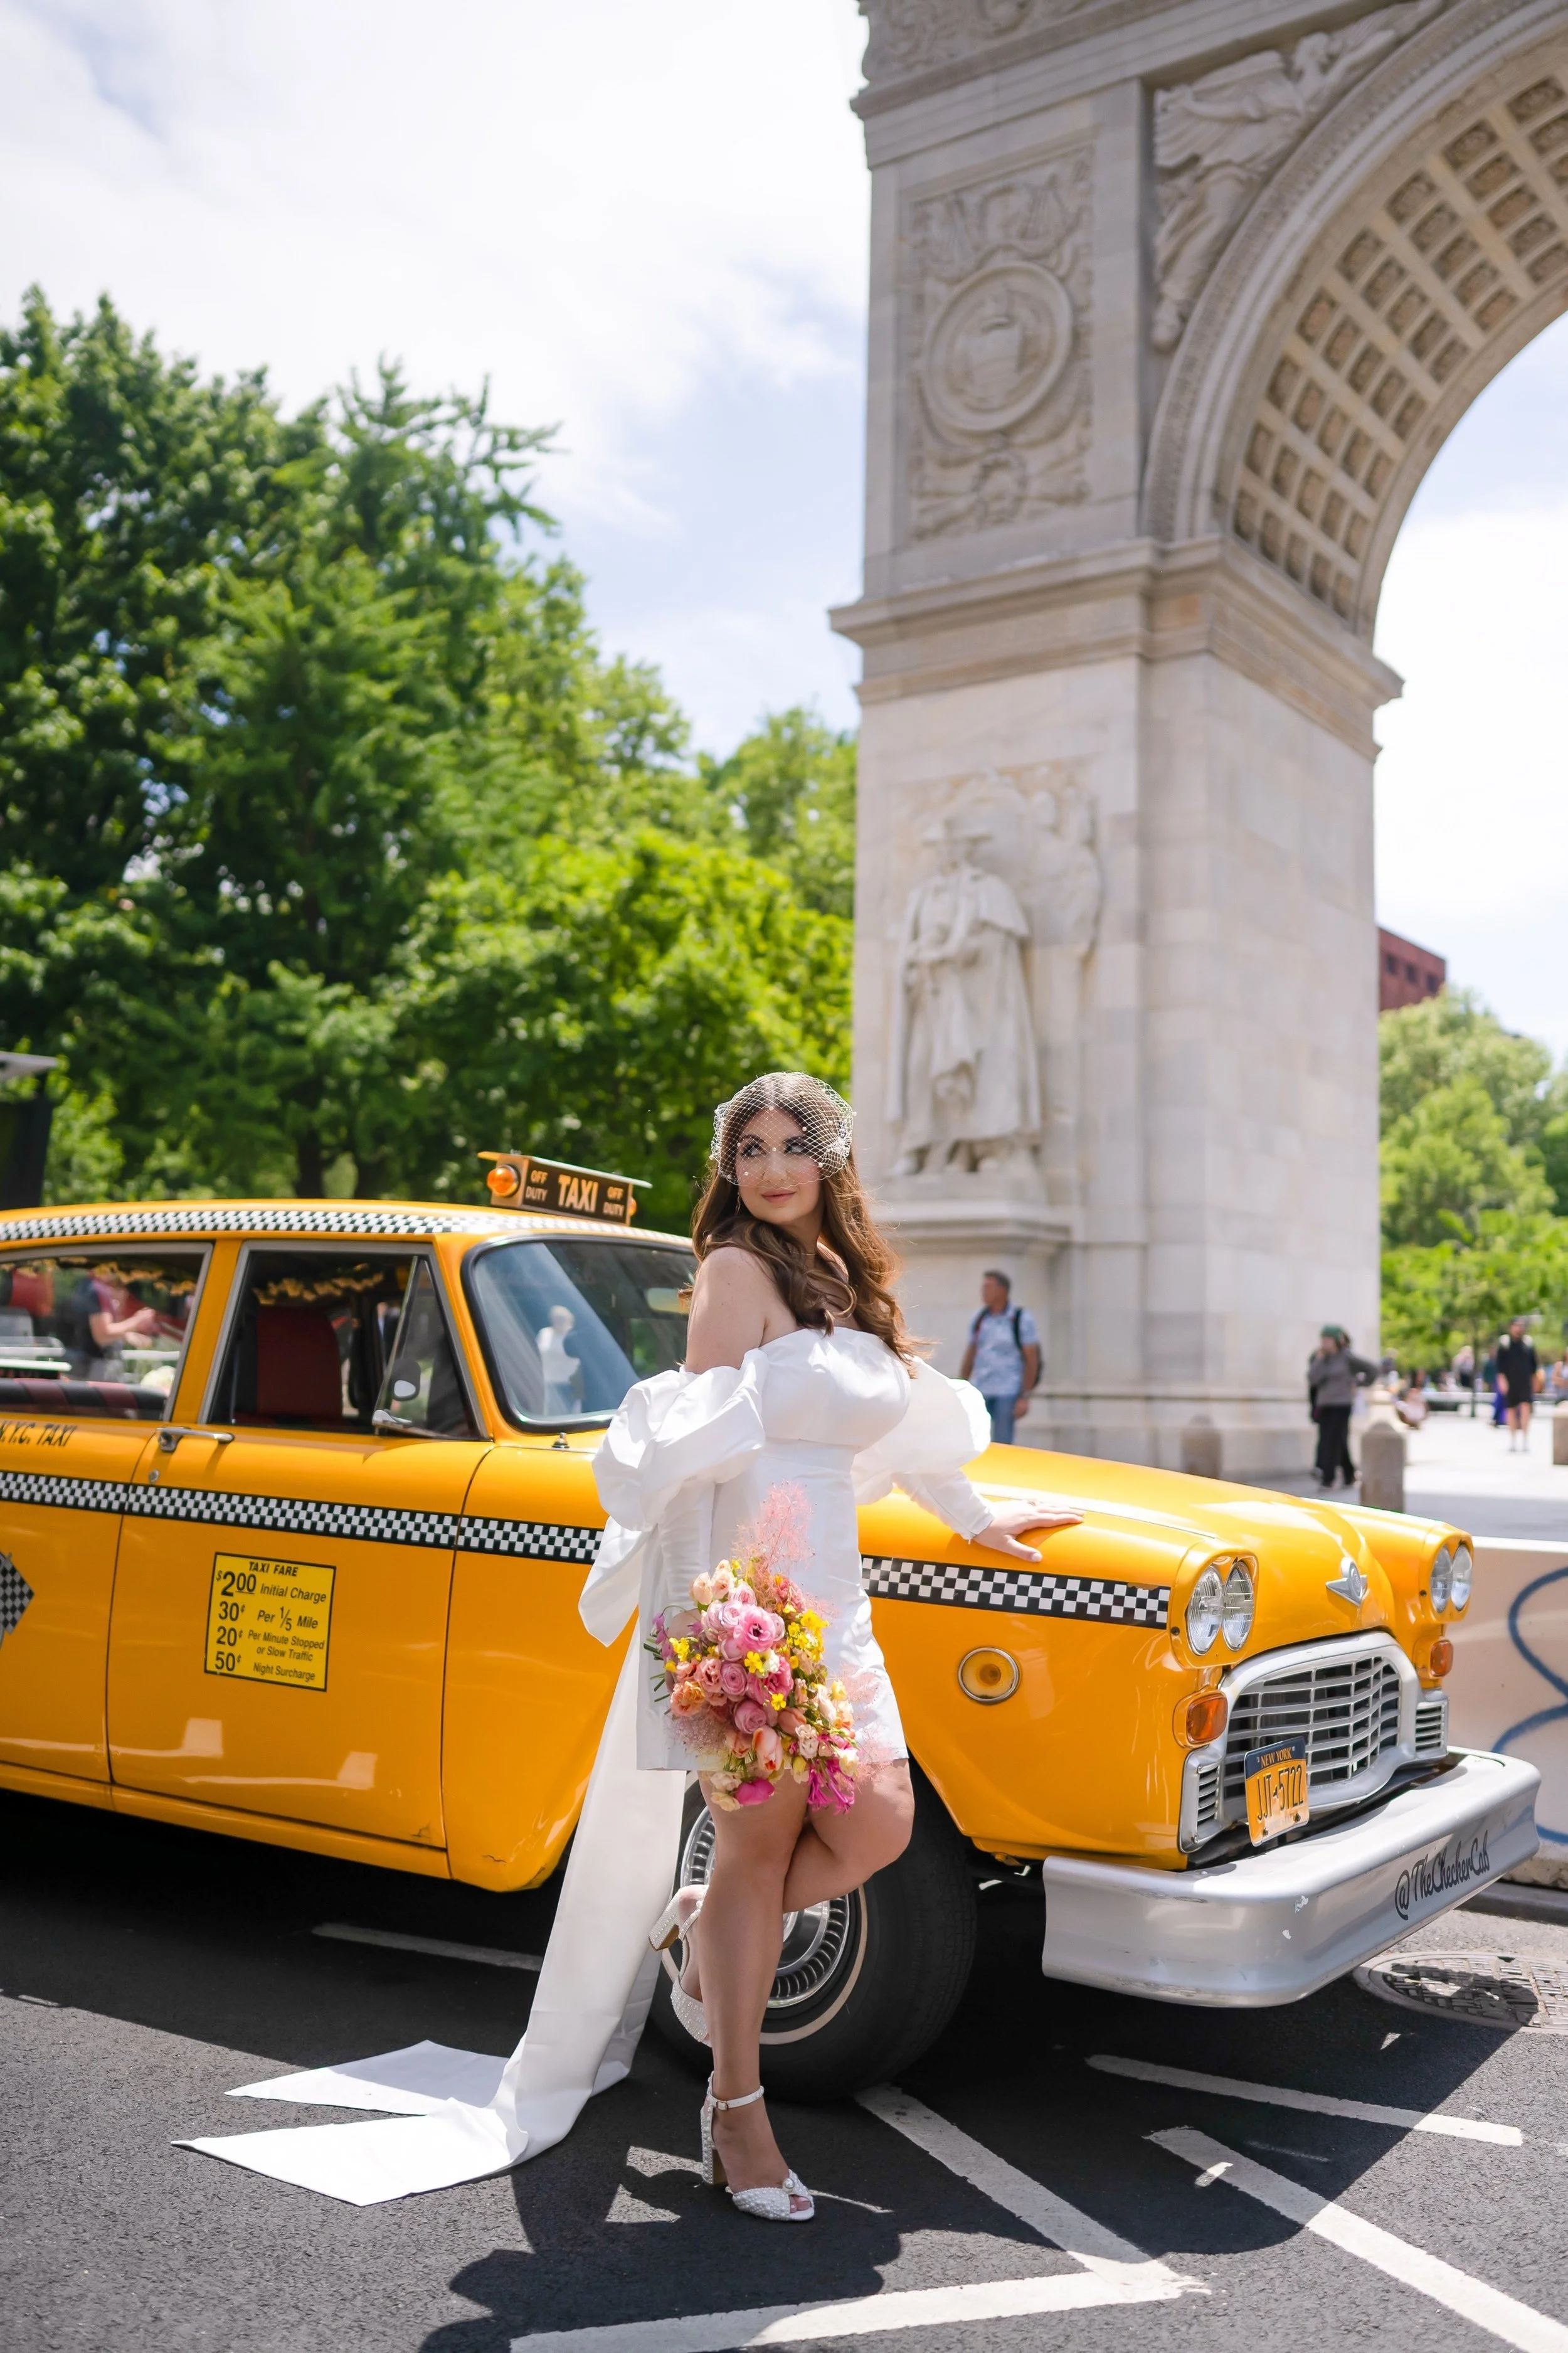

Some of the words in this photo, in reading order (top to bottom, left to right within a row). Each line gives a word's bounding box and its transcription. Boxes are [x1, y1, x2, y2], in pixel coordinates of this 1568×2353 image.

[531, 1170, 548, 1184] OFF
[525, 1186, 548, 1201] DUTY
[558, 1174, 599, 1213] TAXI
[607, 1186, 624, 1200] OFF
[603, 1201, 625, 1217] DUTY
[36, 1423, 78, 1447] TAXI
[249, 1561, 270, 1573] TAXI
[273, 1564, 299, 1576] FARE
[260, 1583, 289, 1597] Initial
[290, 1587, 327, 1604] Charge
[257, 1610, 275, 1623] Per
[297, 1615, 319, 1629] Mile
[248, 1629, 261, 1640] Per
[262, 1632, 289, 1645] Minute
[291, 1635, 325, 1650] Stopped
[257, 1645, 265, 1654] or
[267, 1645, 287, 1657] Slow
[289, 1649, 314, 1662] Traffic
[253, 1662, 273, 1676] Night
[275, 1665, 315, 1682] Surcharge
[1261, 1751, 1275, 1768] NEW
[1276, 1746, 1292, 1761] YORK
[1395, 1829, 1490, 1920] @TheCheckerCab
